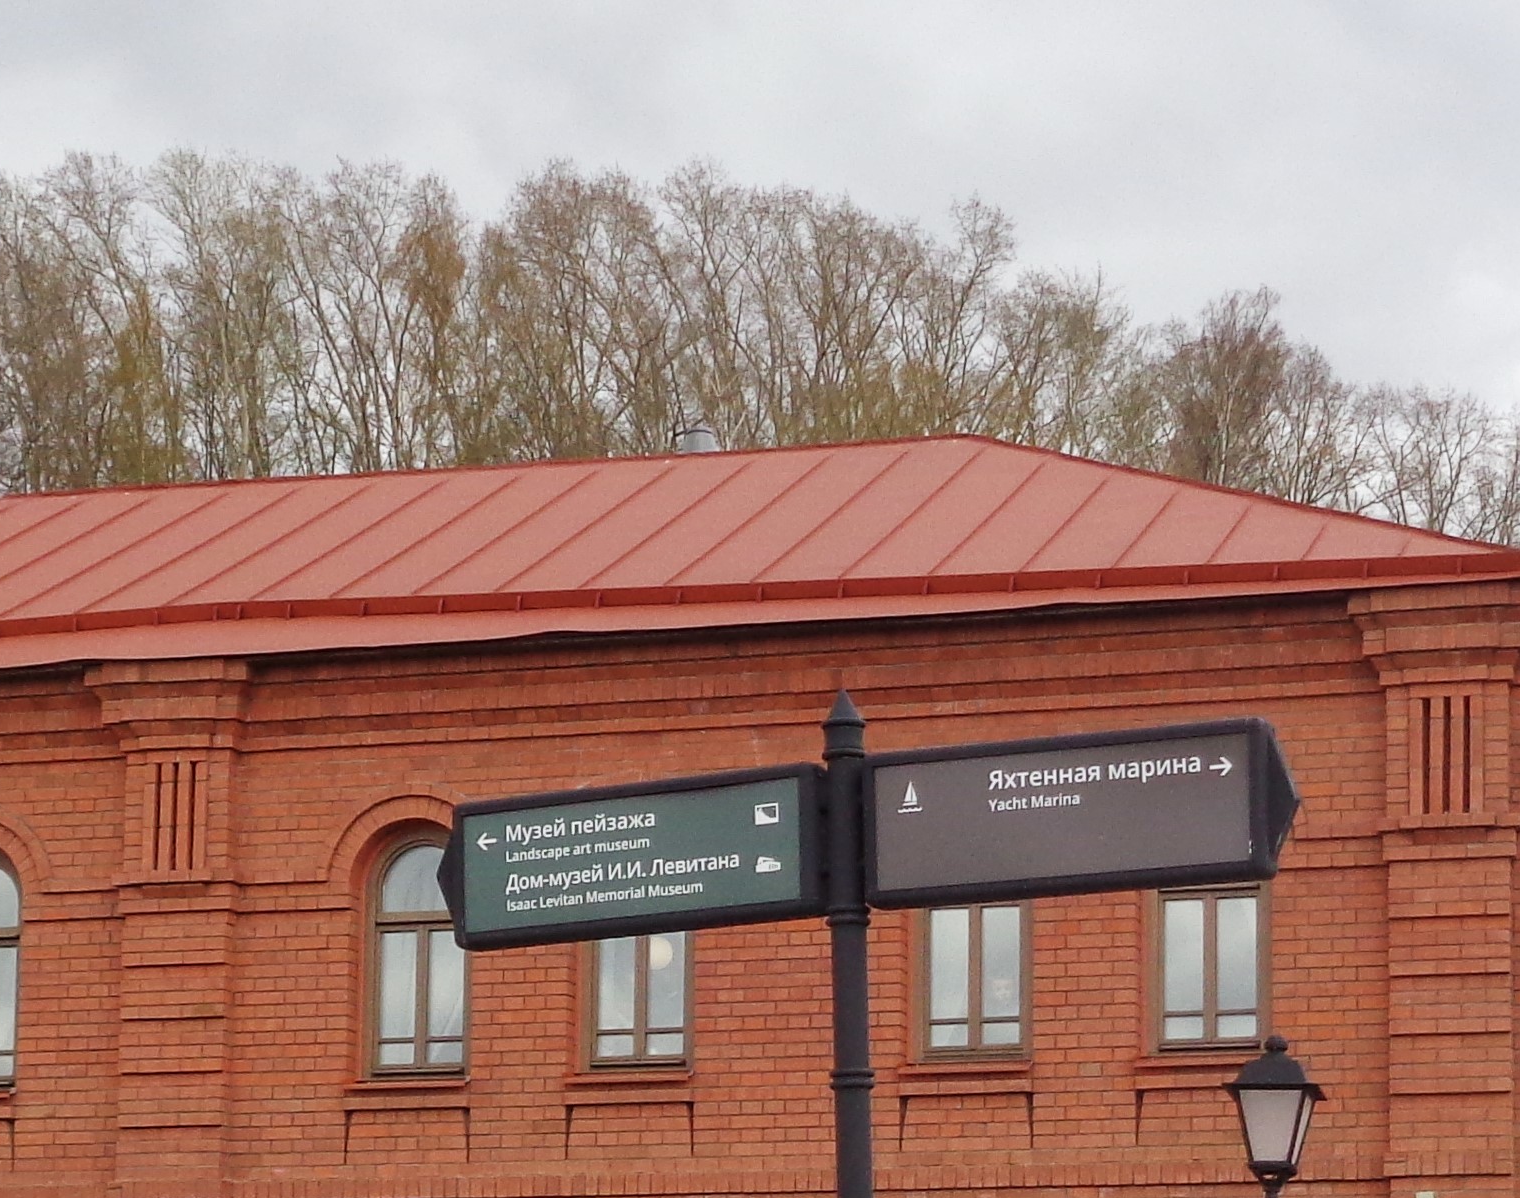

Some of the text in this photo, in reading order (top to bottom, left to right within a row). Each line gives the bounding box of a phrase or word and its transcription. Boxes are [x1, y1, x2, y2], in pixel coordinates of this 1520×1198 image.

[988, 756, 1201, 790] Яхтенная марина
[988, 792, 1081, 812] Yacht Marina
[505, 812, 656, 846] Музей пейзажа
[505, 838, 651, 862] Landscape art museum
[505, 853, 740, 896] Дом-музей И.И. Левитана
[506, 882, 703, 912] Isaac Levitan Memorial Museum
